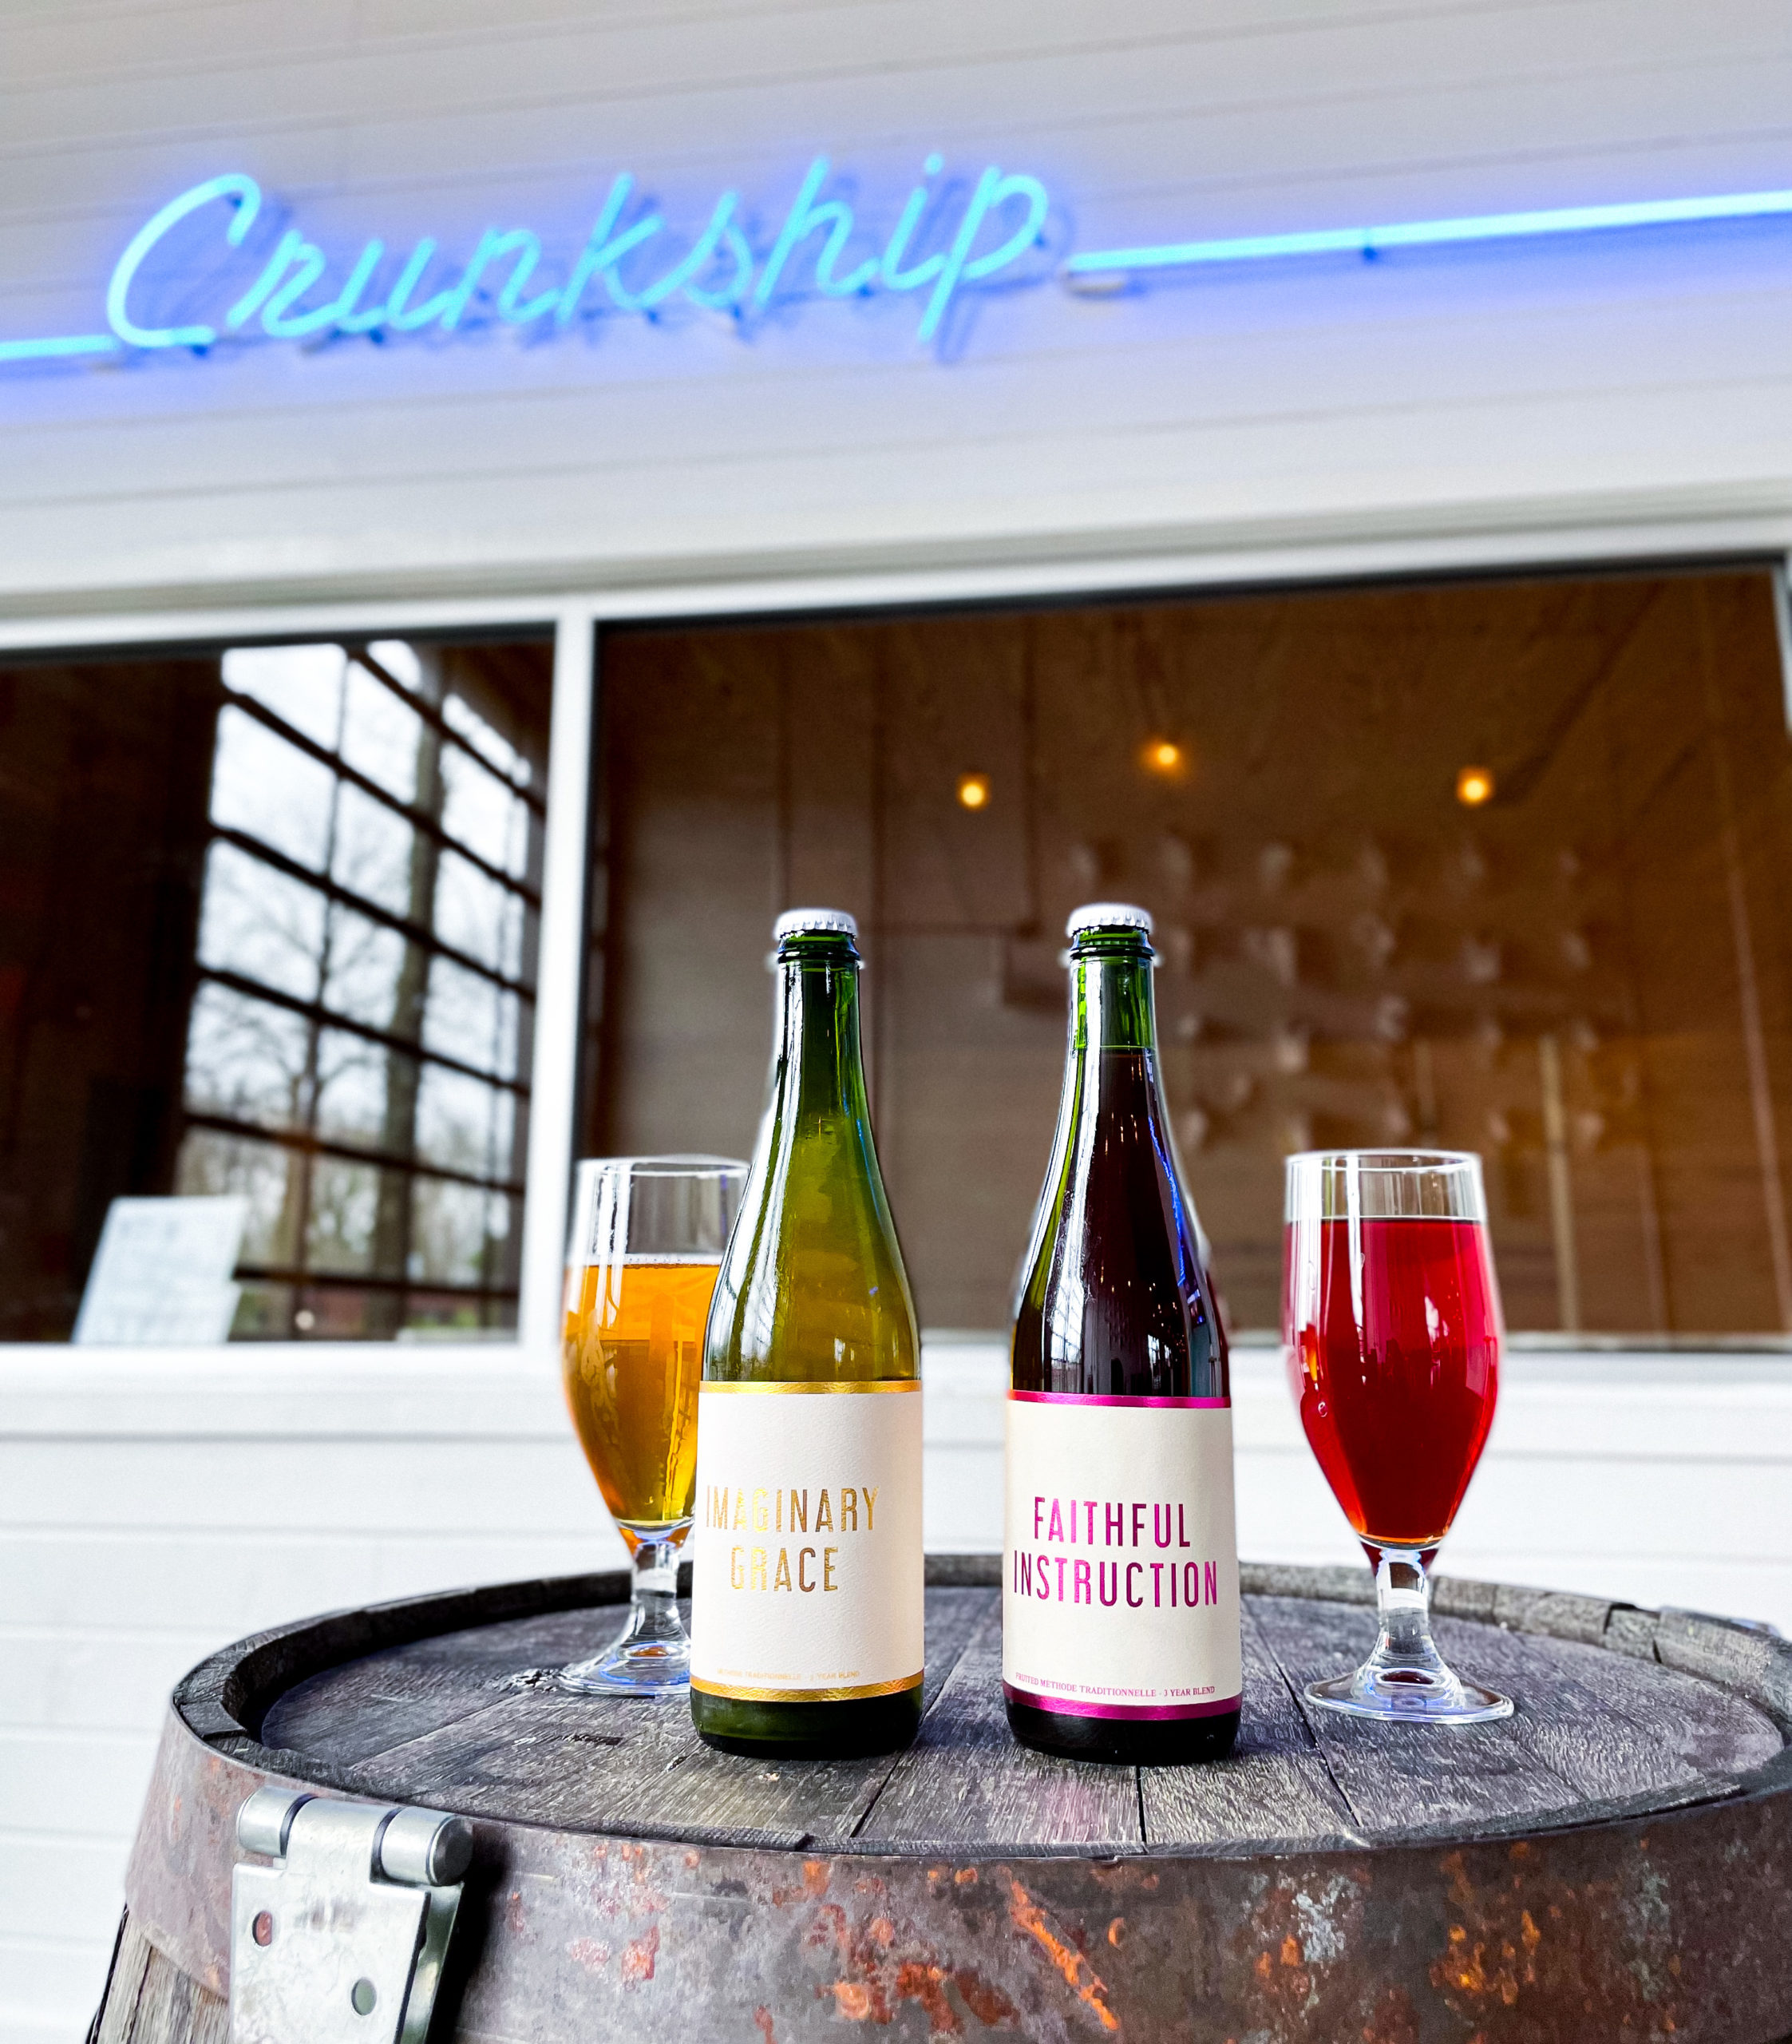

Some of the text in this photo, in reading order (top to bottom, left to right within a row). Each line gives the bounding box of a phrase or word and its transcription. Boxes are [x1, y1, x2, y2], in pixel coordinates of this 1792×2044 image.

[106, 153, 1048, 343] Crunkship
[706, 1485, 879, 1532] IMAGINARY
[1034, 1496, 1190, 1548] FAITHFUL
[730, 1545, 838, 1593] GRACE
[1014, 1550, 1217, 1608] INSTRUCTION
[1015, 1672, 1038, 1686] FRUITED
[1040, 1679, 1078, 1692] METHODE
[1079, 1685, 1156, 1697] TRADITIONNELLE
[1170, 1687, 1191, 1697] YEAR
[1193, 1686, 1215, 1695] BLEND
